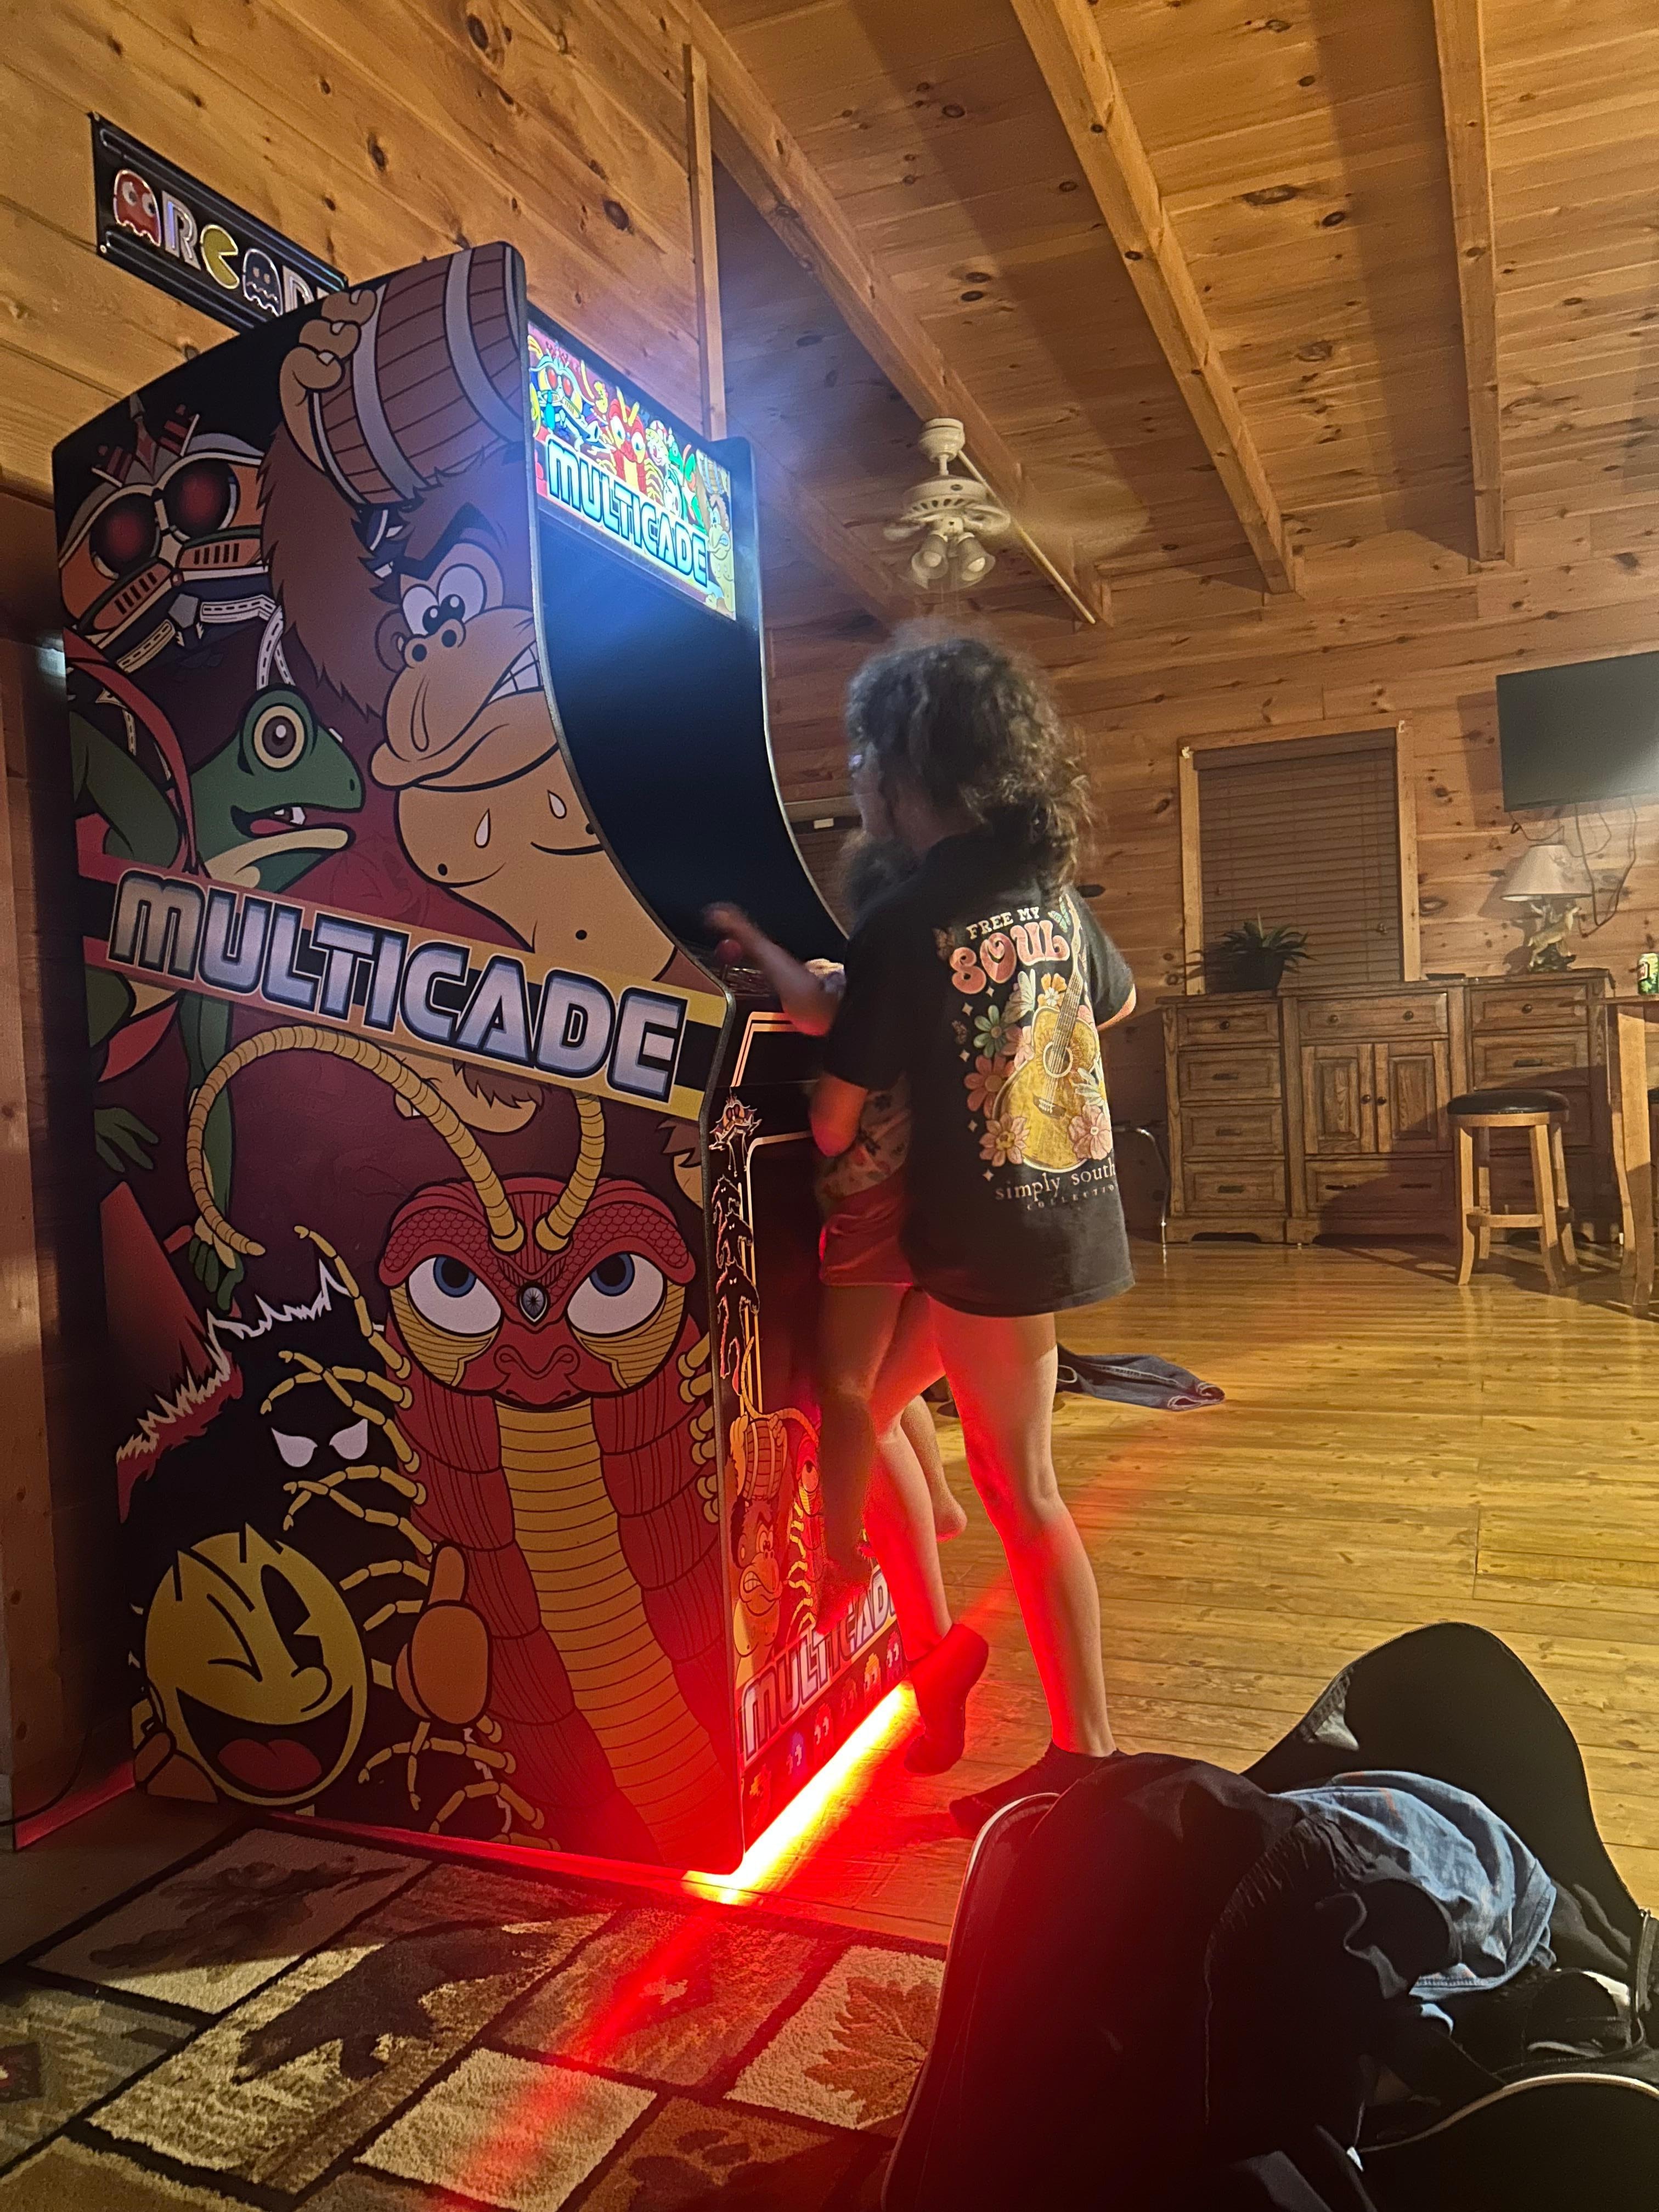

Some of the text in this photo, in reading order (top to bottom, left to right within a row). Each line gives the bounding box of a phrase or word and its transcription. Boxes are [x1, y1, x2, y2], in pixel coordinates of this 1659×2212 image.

[114, 169, 329, 317] ARCAD
[548, 438, 709, 589] MULTICADE
[950, 920, 1070, 994] SOUL
[966, 906, 1040, 940] FREE MY
[109, 870, 688, 1104] MULTICADE
[995, 1157, 1116, 1202] simply south
[1026, 1184, 1114, 1211] COLLECTIO
[743, 1566, 896, 1764] MULTICAD
